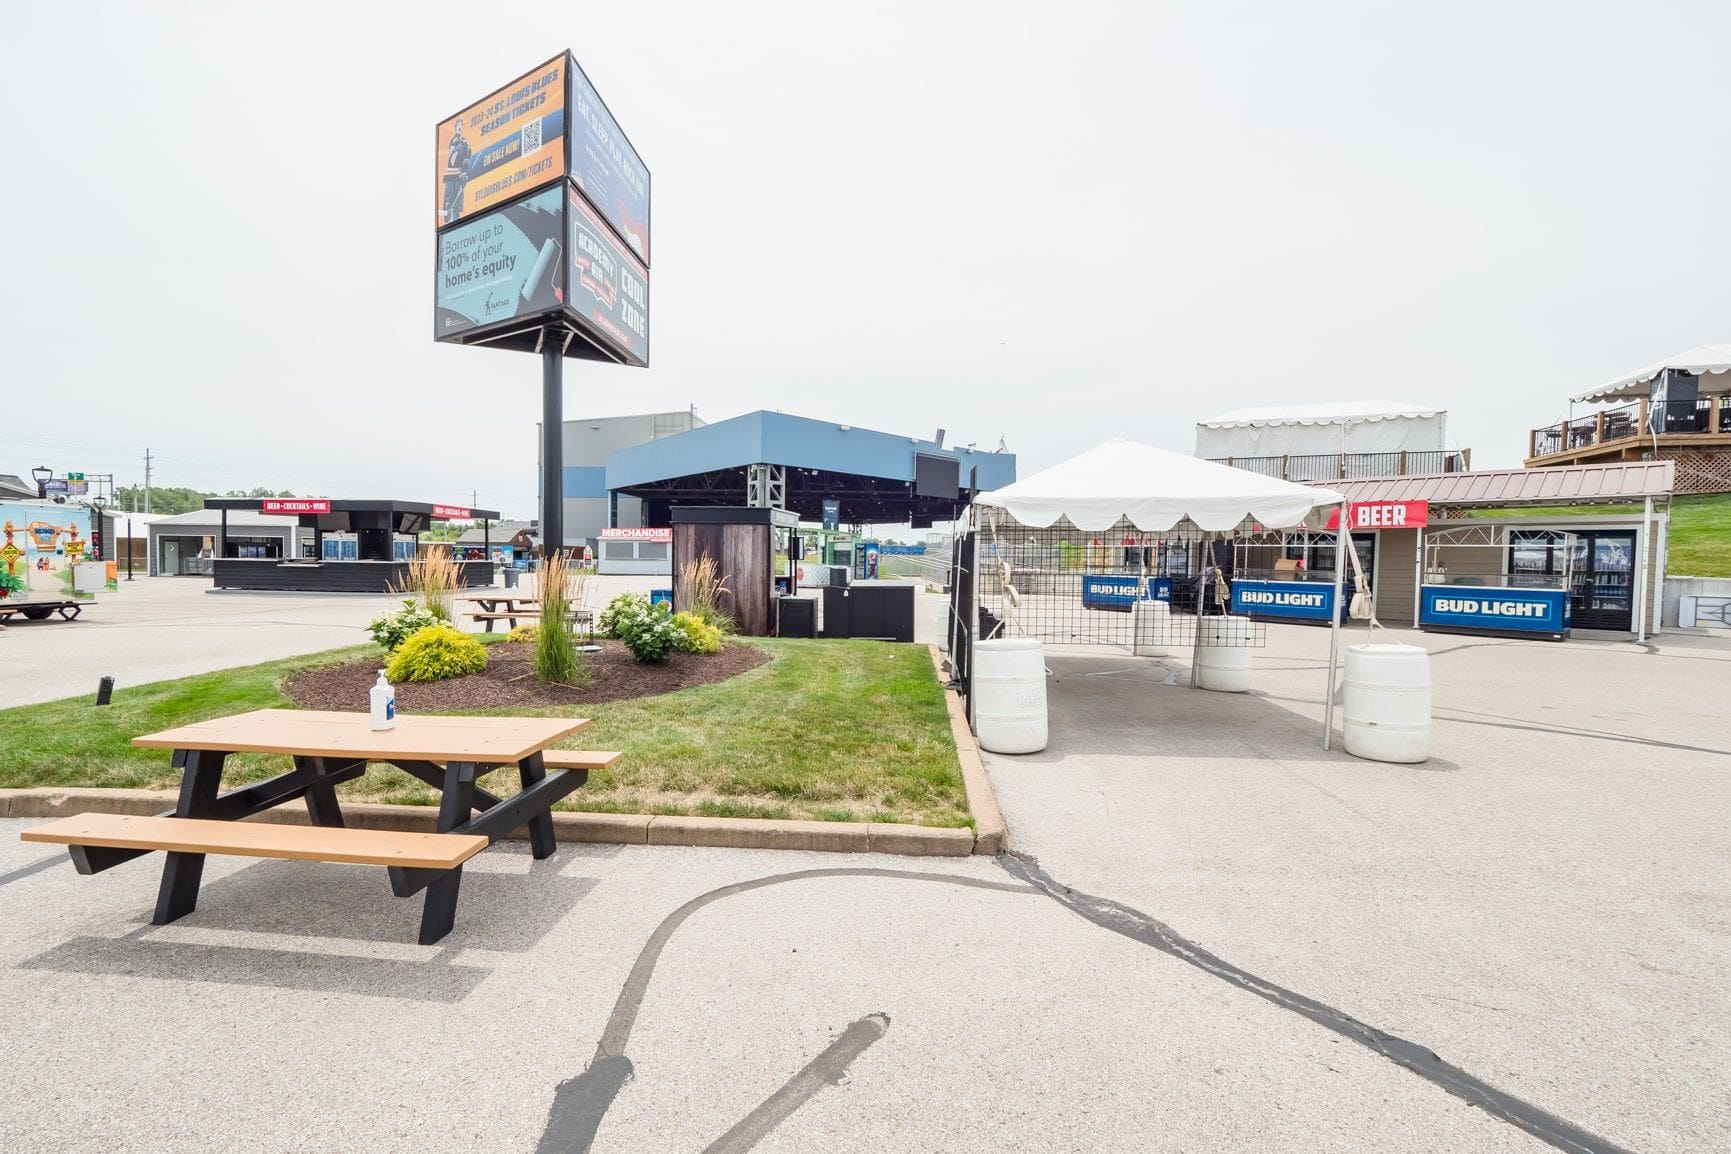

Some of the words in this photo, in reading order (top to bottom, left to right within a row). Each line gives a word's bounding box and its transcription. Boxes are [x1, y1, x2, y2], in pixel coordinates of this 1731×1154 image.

[505, 85, 530, 107] LOUIS
[530, 68, 558, 93] BLUES
[481, 113, 510, 136] SEASON
[511, 92, 546, 120] TICKETS
[491, 146, 505, 163] SALE
[445, 234, 476, 254] Borrow
[479, 229, 491, 246] up
[493, 223, 503, 236] to
[445, 252, 470, 271] 100%
[471, 245, 481, 262] of
[483, 241, 503, 262] your
[579, 233, 614, 278] ACADEMY
[445, 265, 480, 289] home's
[482, 254, 516, 277] equity
[591, 263, 604, 284] AIR
[621, 266, 645, 310] COOL
[621, 299, 645, 339] ZONE
[267, 502, 280, 510] BEER
[1357, 505, 1406, 527] BEER
[602, 528, 670, 538] MERCHANDISE
[1090, 584, 1113, 595] BUD
[1241, 591, 1276, 603] BUD
[1275, 592, 1324, 607] LIGHT
[1435, 599, 1479, 613] BUD
[1481, 601, 1548, 617] LIGHT
